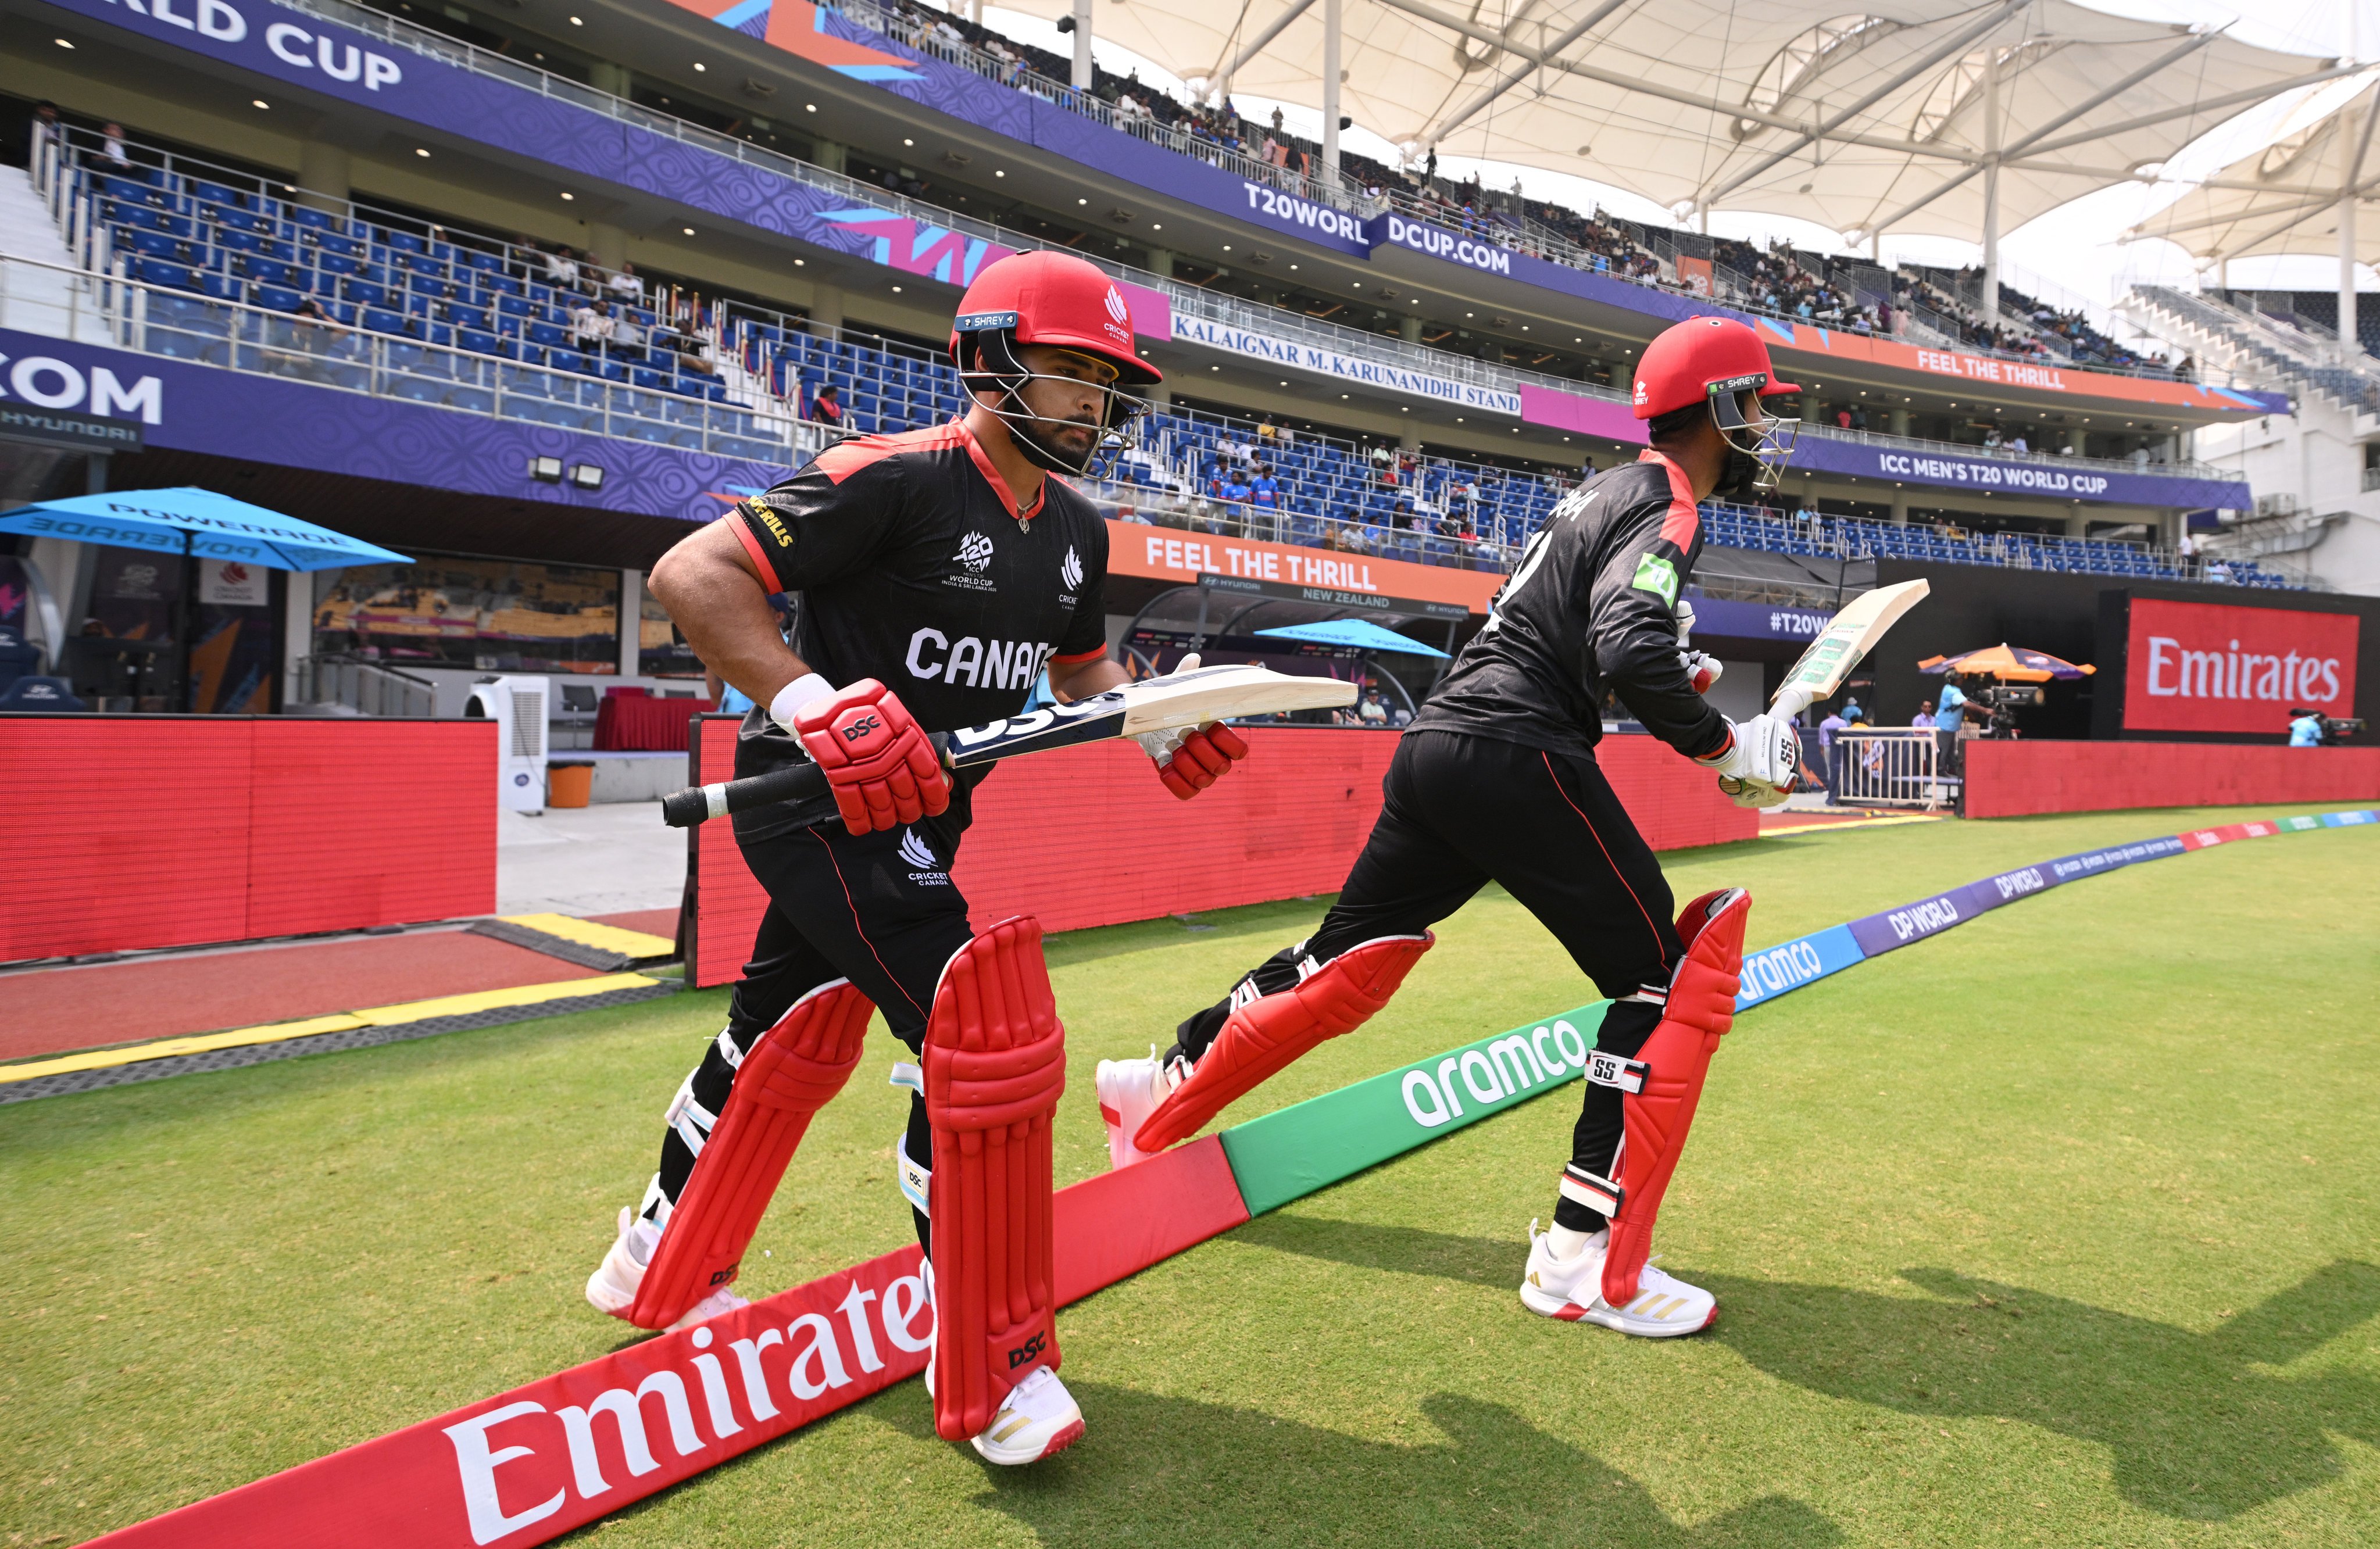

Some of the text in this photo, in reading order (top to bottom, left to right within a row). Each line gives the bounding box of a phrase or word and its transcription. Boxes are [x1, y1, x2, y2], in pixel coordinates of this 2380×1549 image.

[266, 22, 402, 91] CUP
[974, 315, 1005, 327] SHREY
[1104, 323, 1129, 341] CRICKET
[1109, 332, 1127, 345] CANADA
[1175, 314, 1299, 363] KALAIGNAR
[1467, 387, 1520, 412] STAND
[1918, 350, 2065, 389] FEEL THE THRILL
[0, 352, 163, 425] OM
[1728, 375, 1756, 388] SHREY
[1634, 396, 1649, 405] SHREY
[1, 410, 137, 442] HYUNDAI
[1880, 453, 2107, 495] ICC MEN'S T20 WORLD CUP
[107, 503, 353, 547] POWERADE
[1146, 537, 1377, 591] FEEL THE THRILL
[949, 575, 978, 585] WORLD
[1220, 580, 1260, 591] HYUNDAI
[1303, 588, 1389, 608] NEW ZEALAND
[1438, 607, 1468, 616] HYUNDAI
[1770, 612, 1832, 634] #T20W
[2147, 636, 2340, 702] Emirates
[842, 715, 881, 743] DSC
[1781, 738, 1793, 765] SS
[1994, 868, 2044, 899] DP WORLD
[1888, 897, 1958, 940] DP WORLD
[1739, 941, 1821, 1000] aramco
[1401, 1019, 1587, 1128] aramco
[1594, 1058, 1617, 1080] SS
[909, 1171, 921, 1188] DSC
[1008, 1330, 1046, 1369] DSC
[443, 1275, 931, 1546] Emirate
